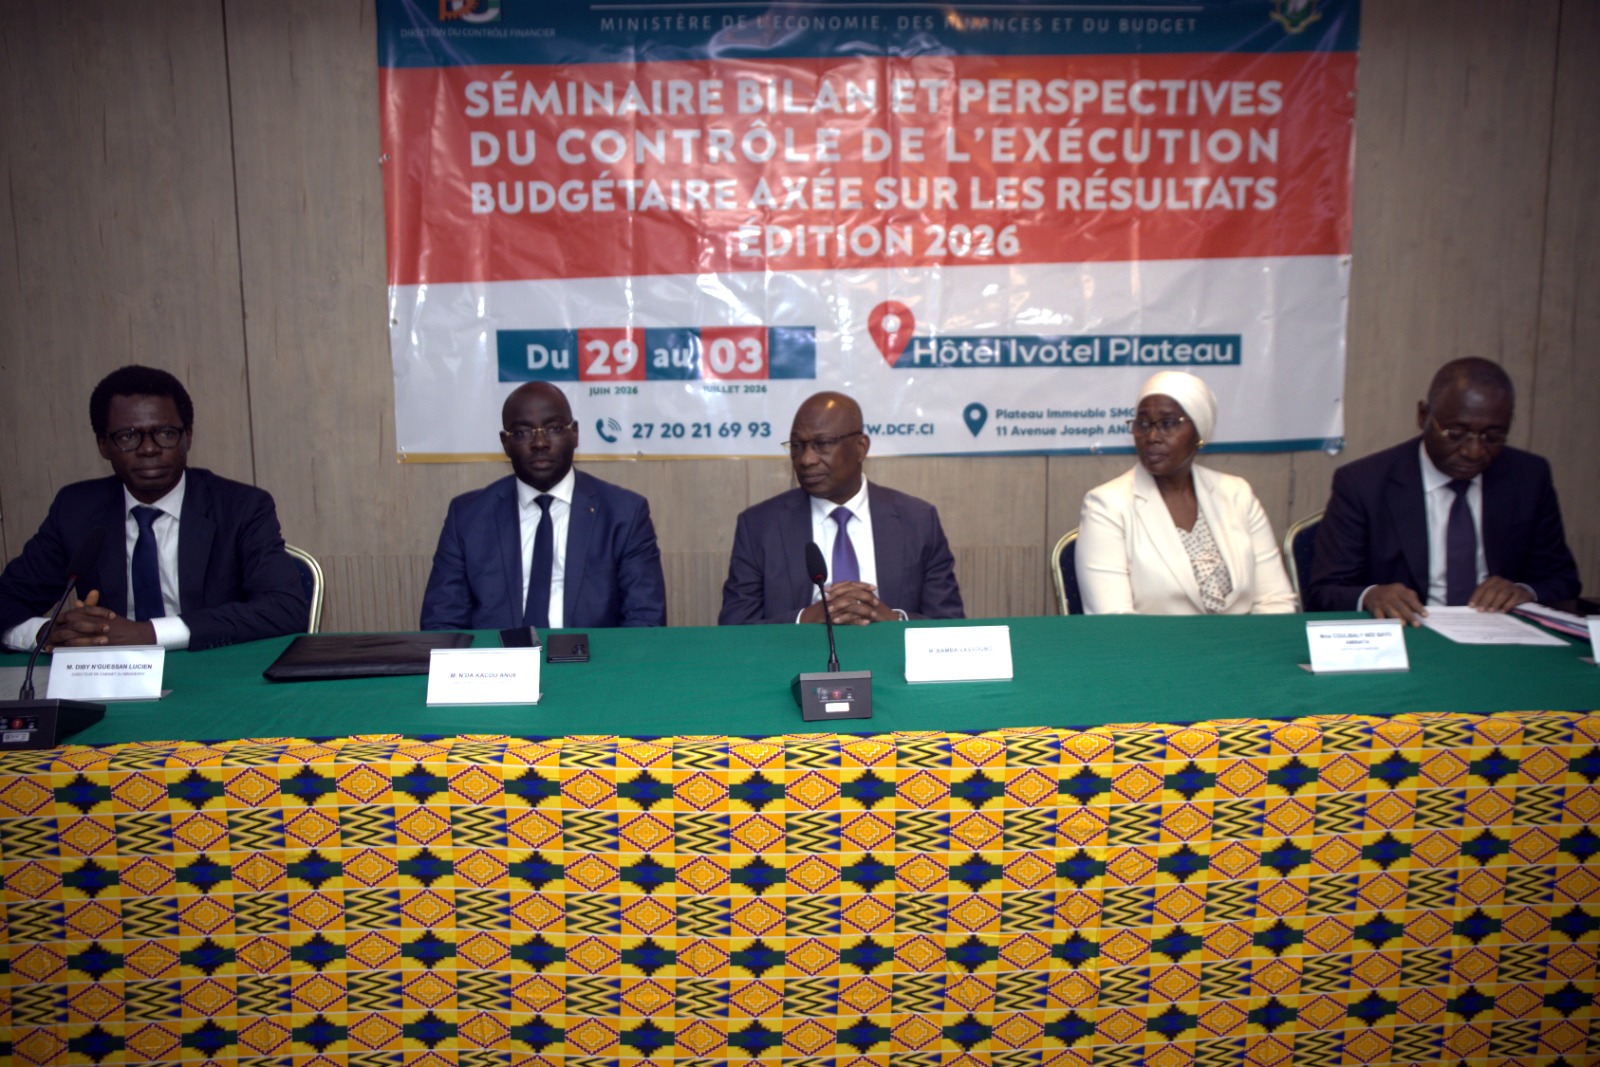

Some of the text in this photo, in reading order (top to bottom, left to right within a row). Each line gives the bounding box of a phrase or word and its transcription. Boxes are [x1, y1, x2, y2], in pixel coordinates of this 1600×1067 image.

[400, 26, 556, 38] DIRECTION DU CONTRÔLE FINANCIER
[600, 13, 712, 31] MINISTÈRE
[722, 15, 746, 30] DE
[897, 15, 934, 30] DES
[1052, 17, 1072, 32] ET
[1082, 17, 1109, 32] DU
[1119, 18, 1197, 33] BUDGET
[465, 71, 1283, 117] SÉMINAIRE BILAN ET PERSPECTIVES
[471, 118, 1279, 167] DU CONTRÔLE DE L'EXÉCUTION
[471, 168, 1278, 214] BUDGÉTAIRE AXÉE SUR LES RÉSULTATS
[738, 215, 1019, 258] ÉDITION 2026
[527, 338, 764, 376] Du 29 au 03
[913, 336, 1233, 364] Hôtel Ivotel Plateau
[589, 386, 639, 396] JUIN 2026
[703, 384, 767, 394] JUILLET 2026
[995, 409, 1043, 419] Plateau
[1047, 408, 1107, 419] Immeuble
[632, 421, 771, 438] 27 20 21 69 93
[863, 423, 935, 436] W.DCF.CI
[996, 426, 1007, 436] 11
[1011, 425, 1057, 436] Avenue
[1060, 424, 1104, 437] Joseph
